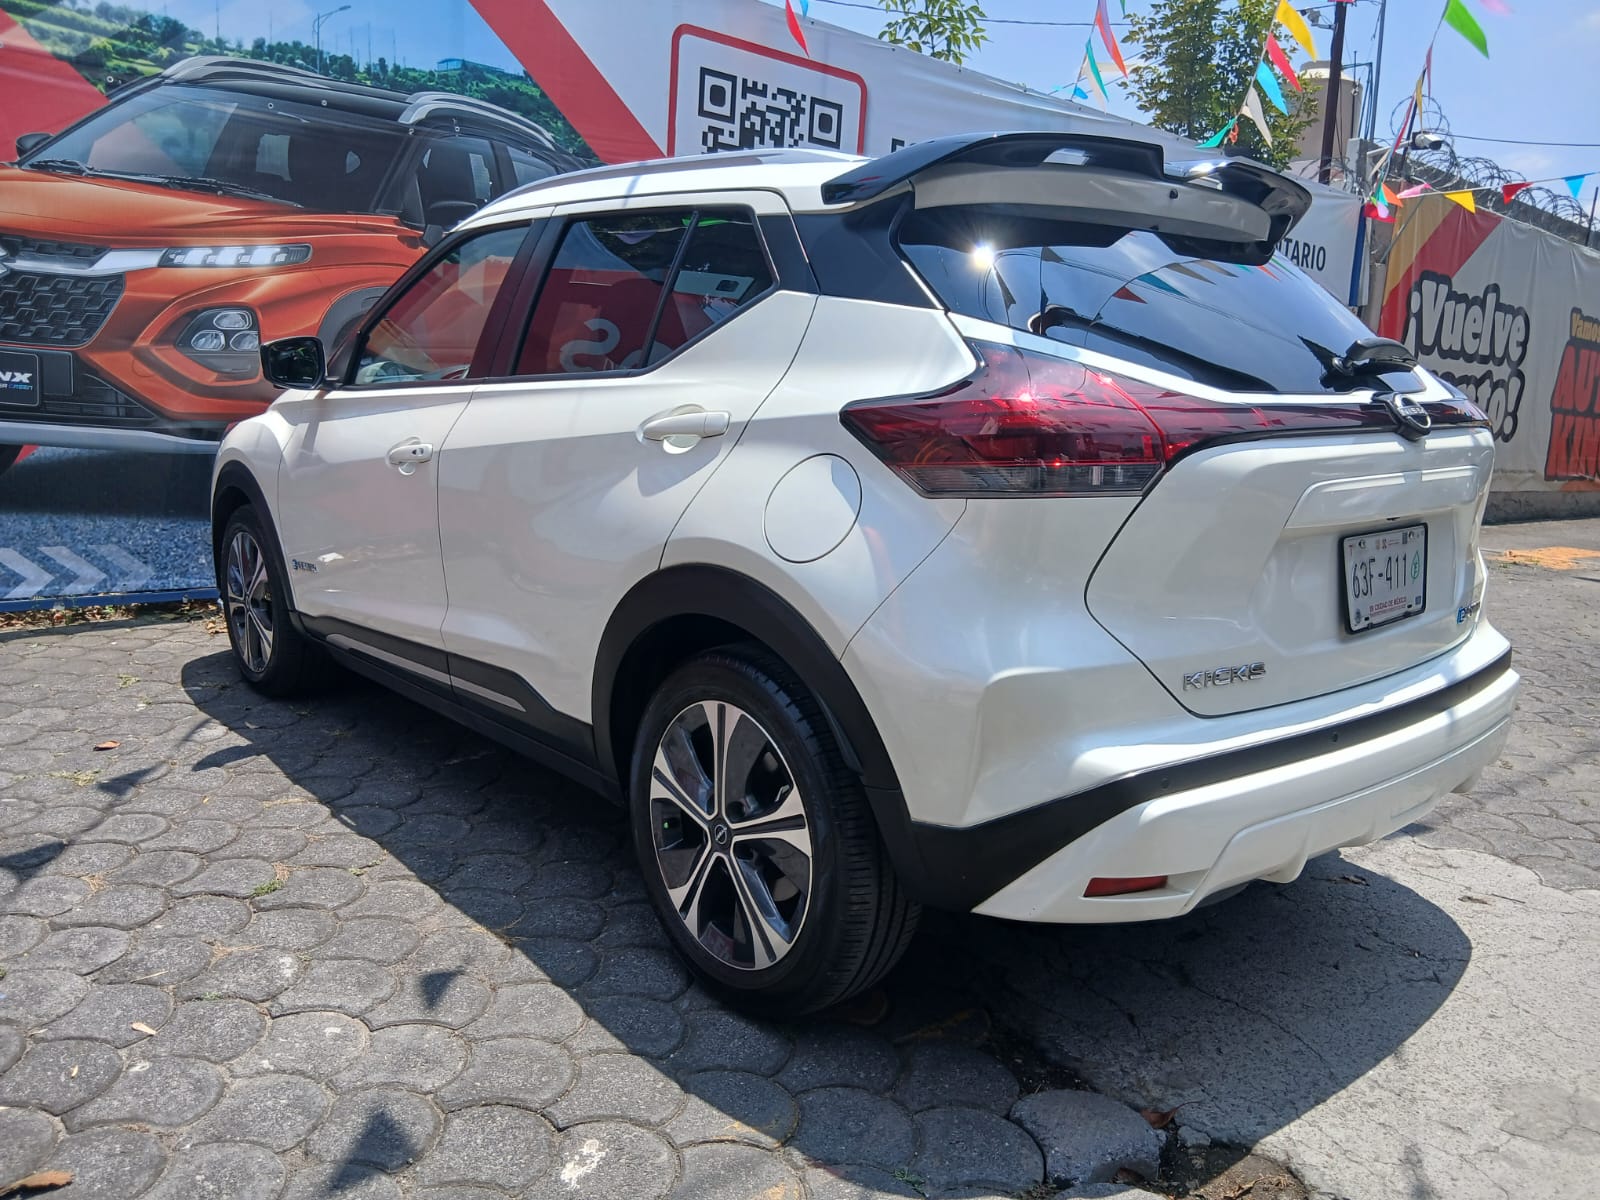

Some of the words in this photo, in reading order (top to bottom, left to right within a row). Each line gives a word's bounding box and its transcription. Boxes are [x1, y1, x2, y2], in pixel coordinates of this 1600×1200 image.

[1403, 275, 1528, 363] ¡Vuelve
[1353, 553, 1407, 599] 63F-411
[1183, 662, 1266, 691] KICKS
